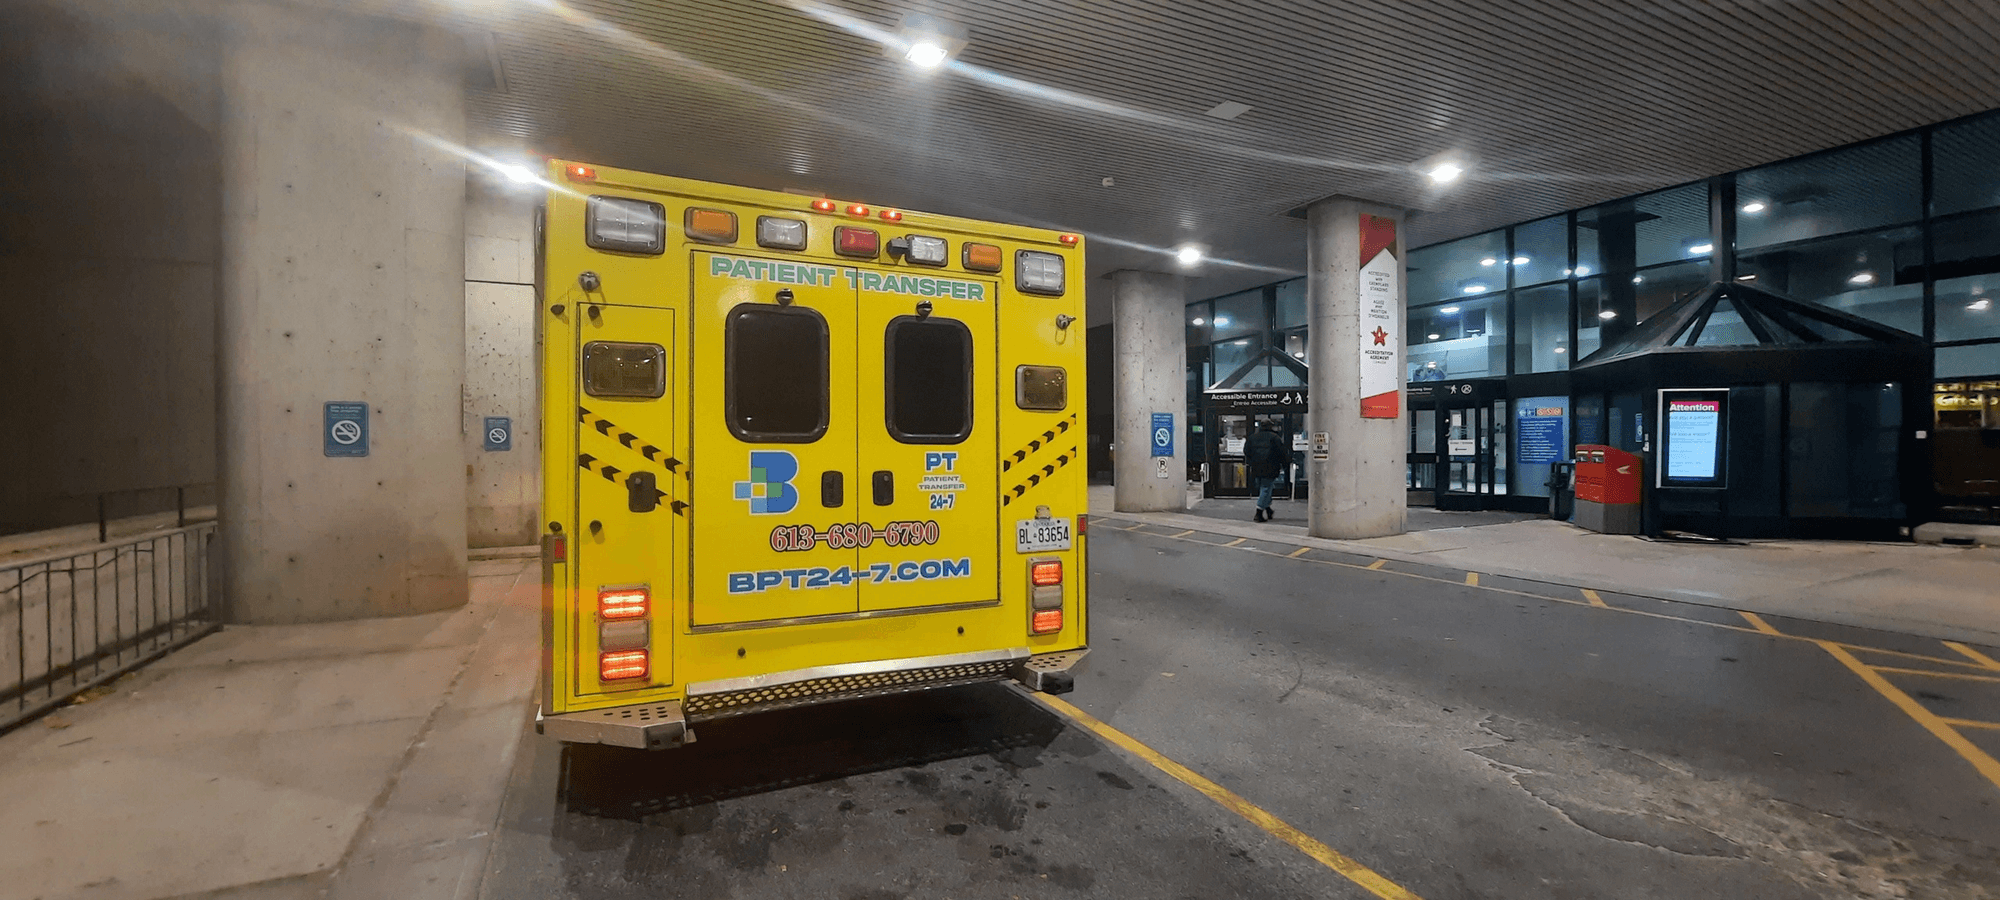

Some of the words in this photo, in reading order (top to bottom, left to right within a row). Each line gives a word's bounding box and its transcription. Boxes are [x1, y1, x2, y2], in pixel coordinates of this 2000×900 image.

[710, 256, 837, 287] PATIENT
[843, 269, 985, 301] TRANSFER
[1669, 403, 1715, 412] Attention
[924, 452, 958, 471] PT
[923, 476, 960, 484] PATIENT
[929, 494, 954, 510] 24-7
[770, 520, 940, 552] 613-680-6790
[727, 557, 971, 595] BPT24-7.COM
